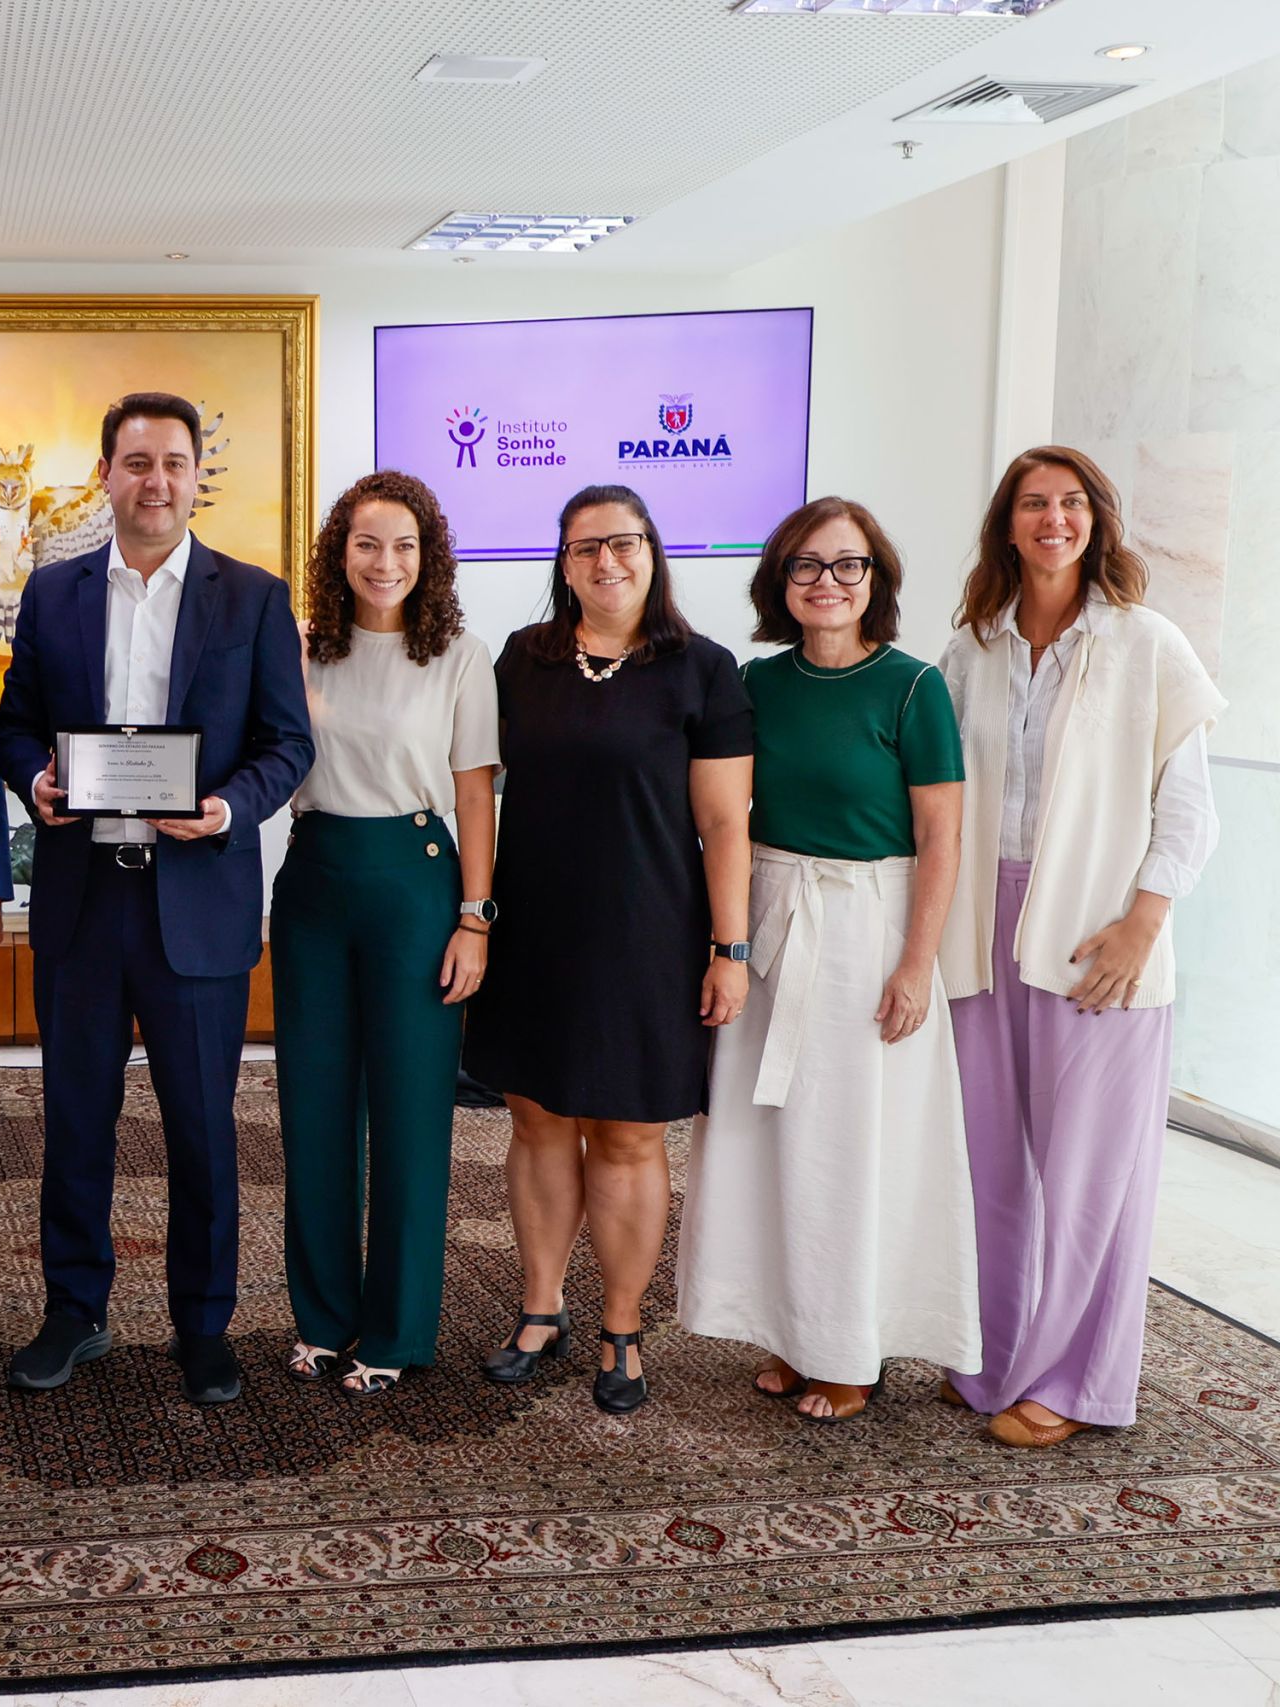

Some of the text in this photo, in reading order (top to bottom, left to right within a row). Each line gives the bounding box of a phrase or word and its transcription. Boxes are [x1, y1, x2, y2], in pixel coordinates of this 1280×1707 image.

[497, 420, 567, 434] Instituto
[497, 435, 555, 450] Sonho
[619, 434, 732, 459] PARANÁ
[497, 451, 566, 467] Grande
